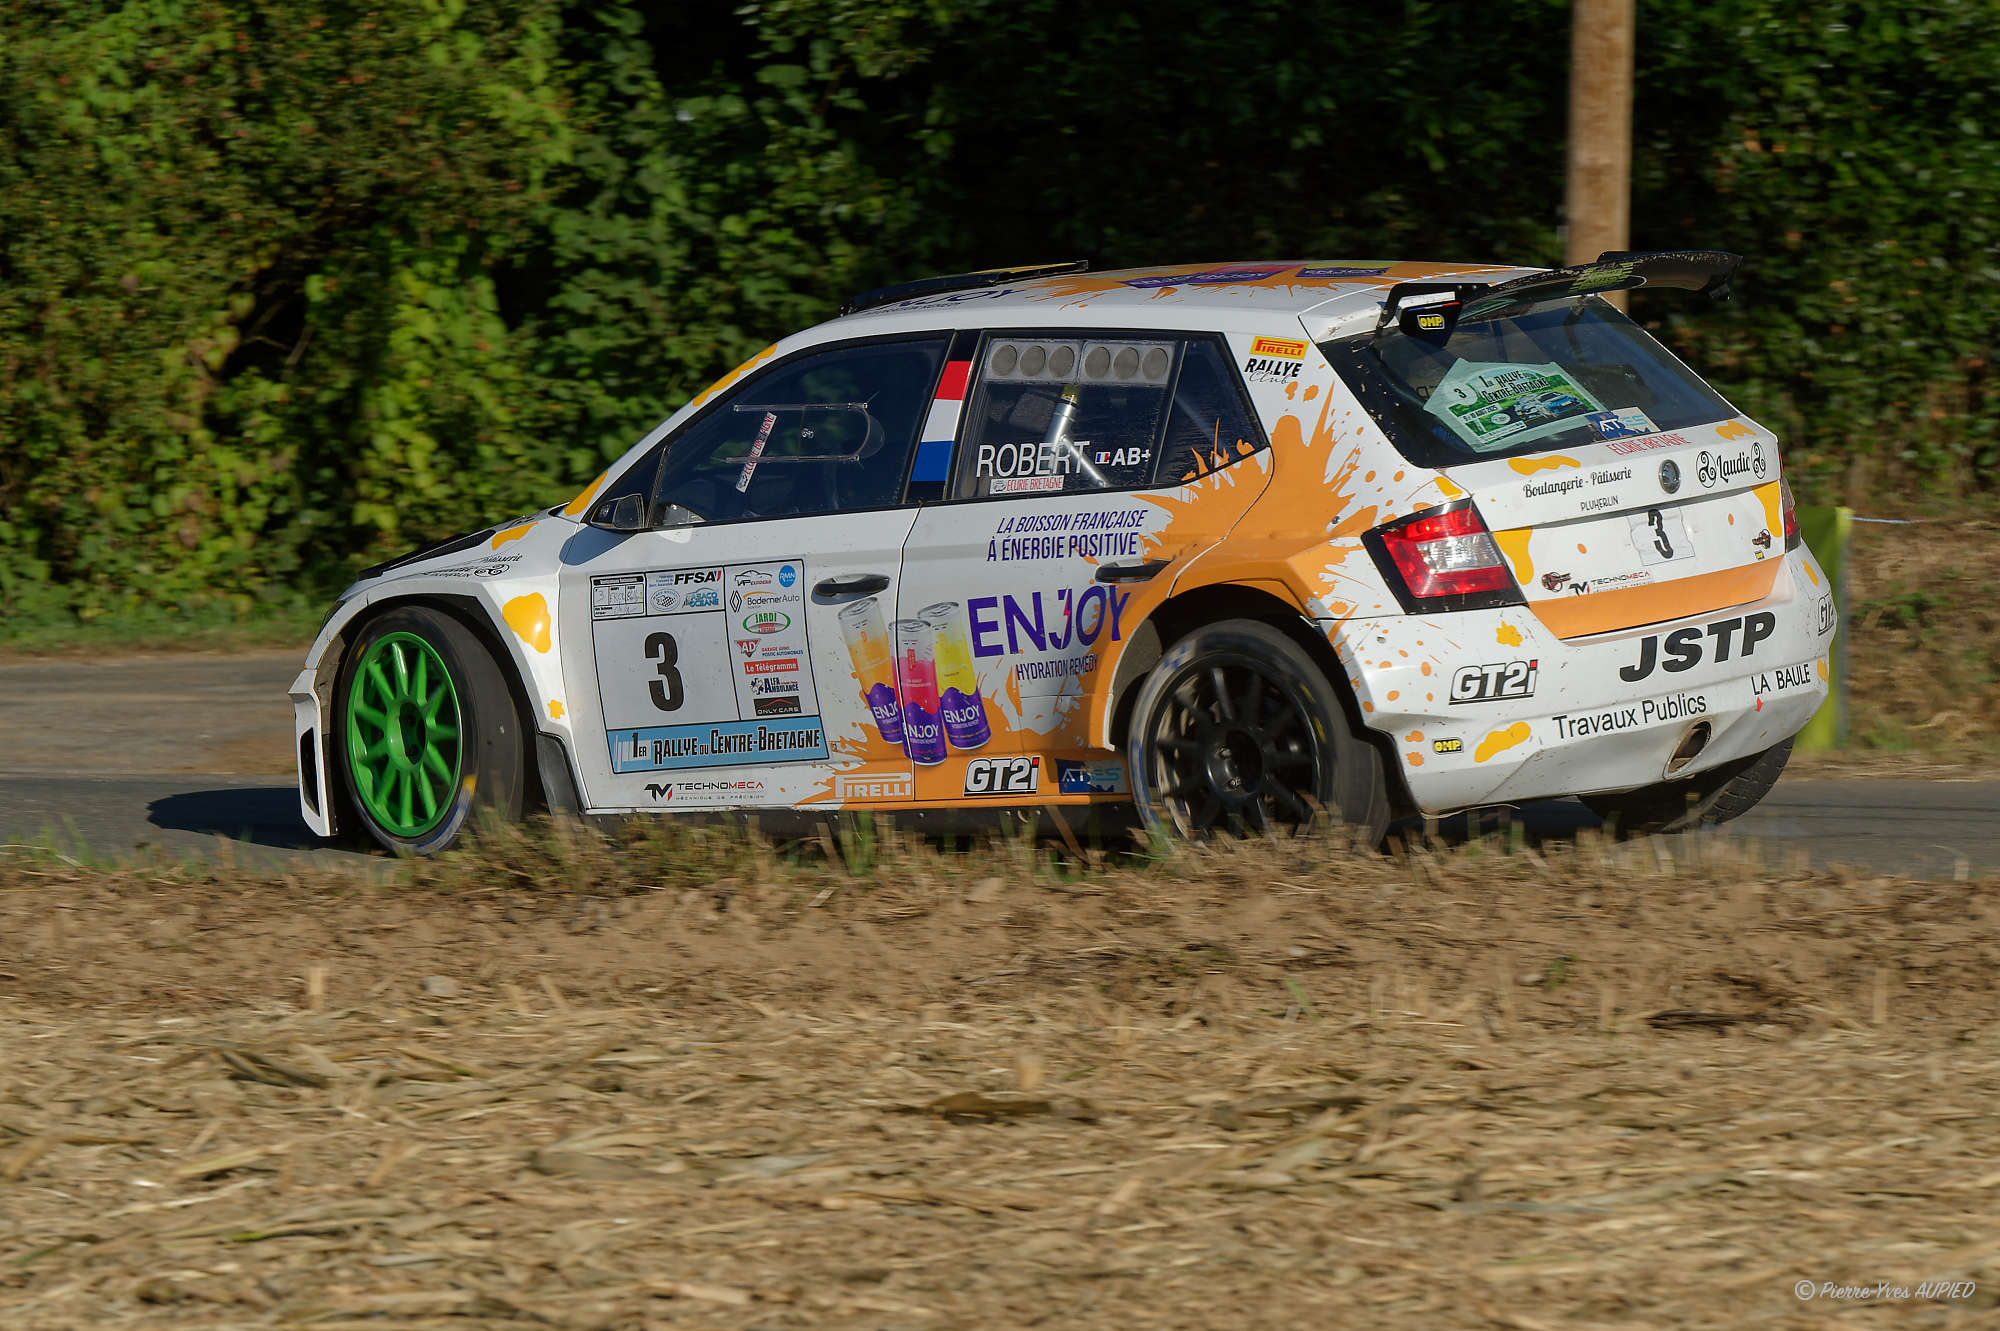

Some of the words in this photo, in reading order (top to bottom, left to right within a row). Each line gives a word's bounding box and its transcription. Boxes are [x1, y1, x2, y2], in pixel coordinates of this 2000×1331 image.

[1419, 316, 1443, 328] OMP
[1255, 339, 1305, 356] PIRELLI
[1244, 358, 1303, 377] RALLYE
[1249, 369, 1293, 384] Club
[1494, 370, 1524, 388] RALLYE
[1453, 388, 1467, 399] 3
[1481, 377, 1551, 403] CENTRE-BRETAGNE
[976, 441, 1091, 478] ROBERT
[1111, 447, 1151, 467] AB+
[1006, 479, 1028, 492] ECURIE
[1029, 477, 1063, 491] BRETAGNE
[1523, 476, 1584, 498] Boulangerie
[1590, 467, 1632, 487] Pâtisserie
[1580, 496, 1619, 511] PLUHERLIN
[996, 517, 1015, 533] LA
[1015, 514, 1073, 533] BOISSON
[1071, 510, 1148, 530] FRANÇAISE
[1648, 509, 1674, 559] 3
[987, 536, 997, 561] À
[1001, 535, 1065, 561] ÉNERGIE
[1069, 532, 1139, 558] POSITIVE
[674, 571, 718, 585] FFSA
[1591, 571, 1650, 585] TECHNOMECA
[755, 612, 777, 623] JARDI
[967, 585, 1131, 658] ENJOY
[742, 641, 756, 653] AD
[1619, 611, 1776, 683] JSTP
[645, 631, 684, 712] 3
[746, 664, 754, 672] Le
[755, 663, 797, 673] Télégramme
[1016, 659, 1068, 681] HYDRATION
[1069, 654, 1098, 676] REMEDY
[1450, 659, 1538, 701] GT2i
[1751, 674, 1771, 695] LA
[1775, 664, 1811, 690] BAULE
[944, 705, 980, 724] ENJOY
[1552, 708, 1638, 739] Travaux
[1642, 695, 1707, 724] Publics
[653, 737, 698, 765] RALLYE
[700, 744, 709, 756] DU
[710, 726, 820, 755] CENTRE-BRETAGNE
[1434, 740, 1461, 752] OMP
[676, 781, 765, 791] TECHNOMECA
[835, 772, 911, 799] PIRELLI
[965, 756, 1040, 795] GT2i
